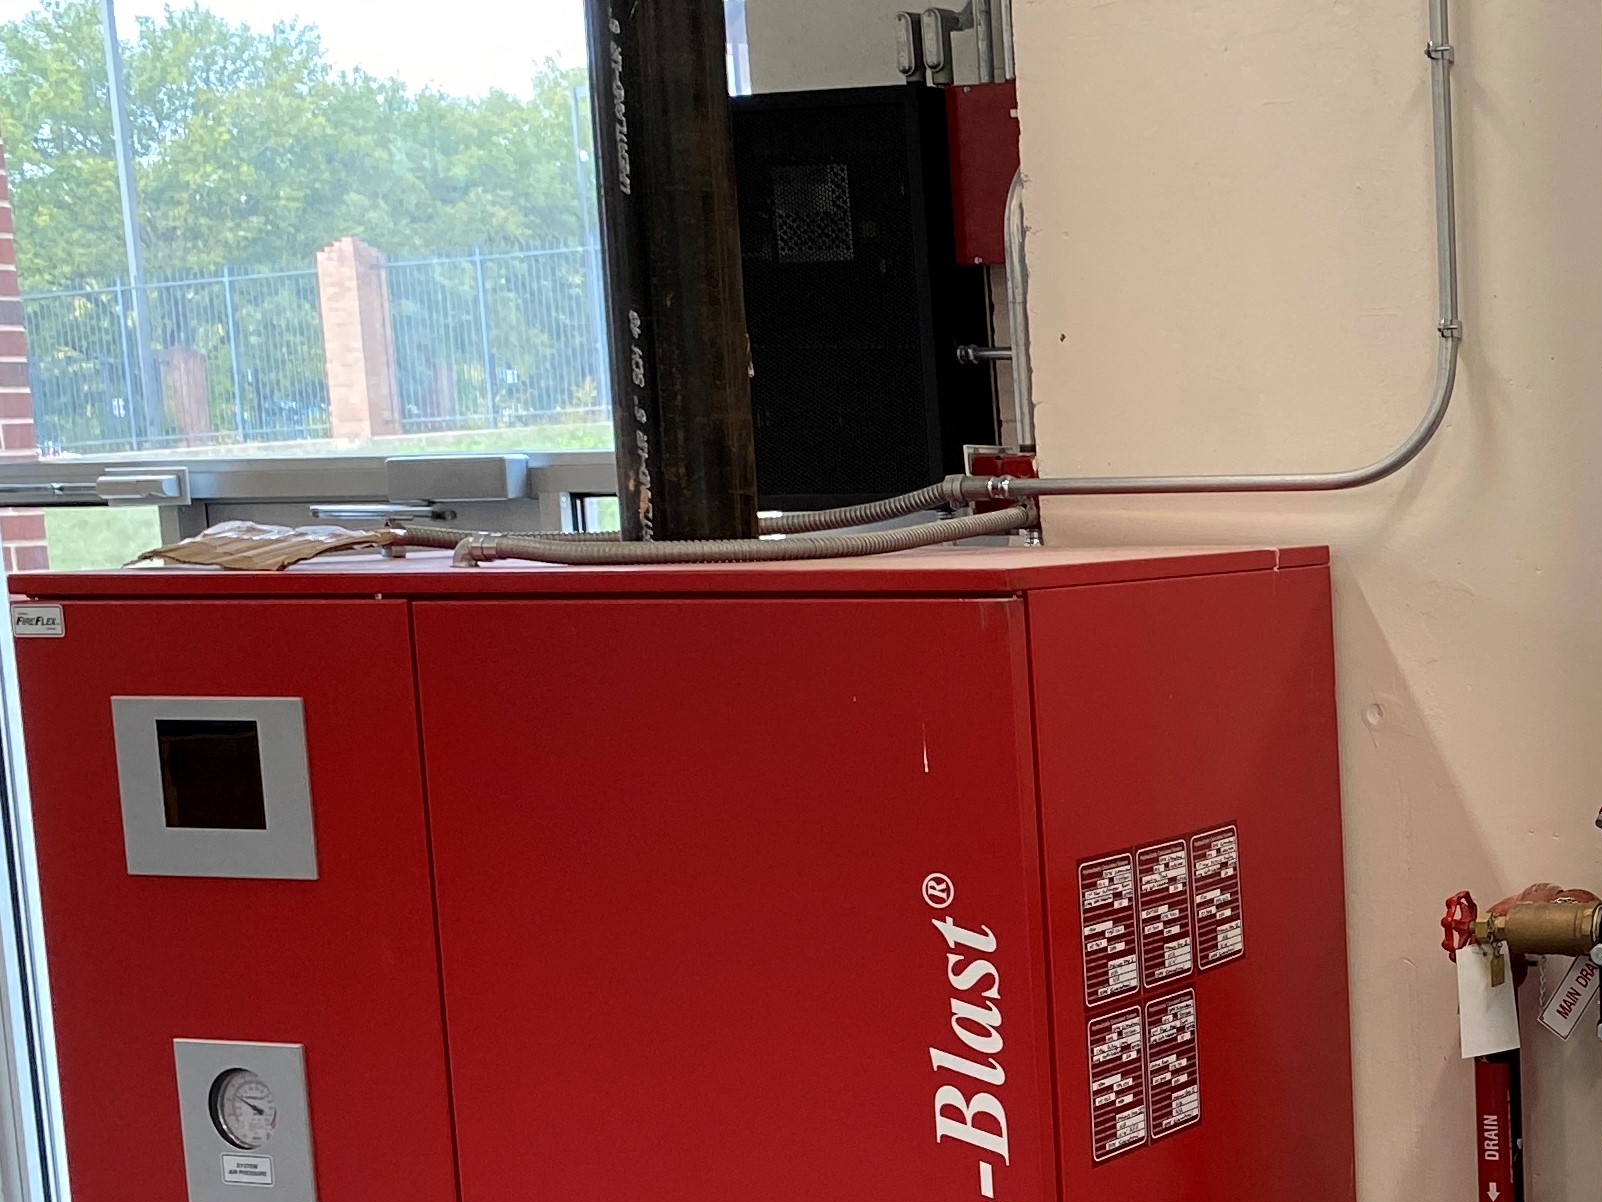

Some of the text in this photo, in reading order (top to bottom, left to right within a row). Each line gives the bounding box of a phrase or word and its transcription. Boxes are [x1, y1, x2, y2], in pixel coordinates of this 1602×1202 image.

[631, 344, 645, 388] SCH
[1556, 962, 1599, 1020] MAIN DRA
[1483, 1114, 1500, 1161] DRAIN
